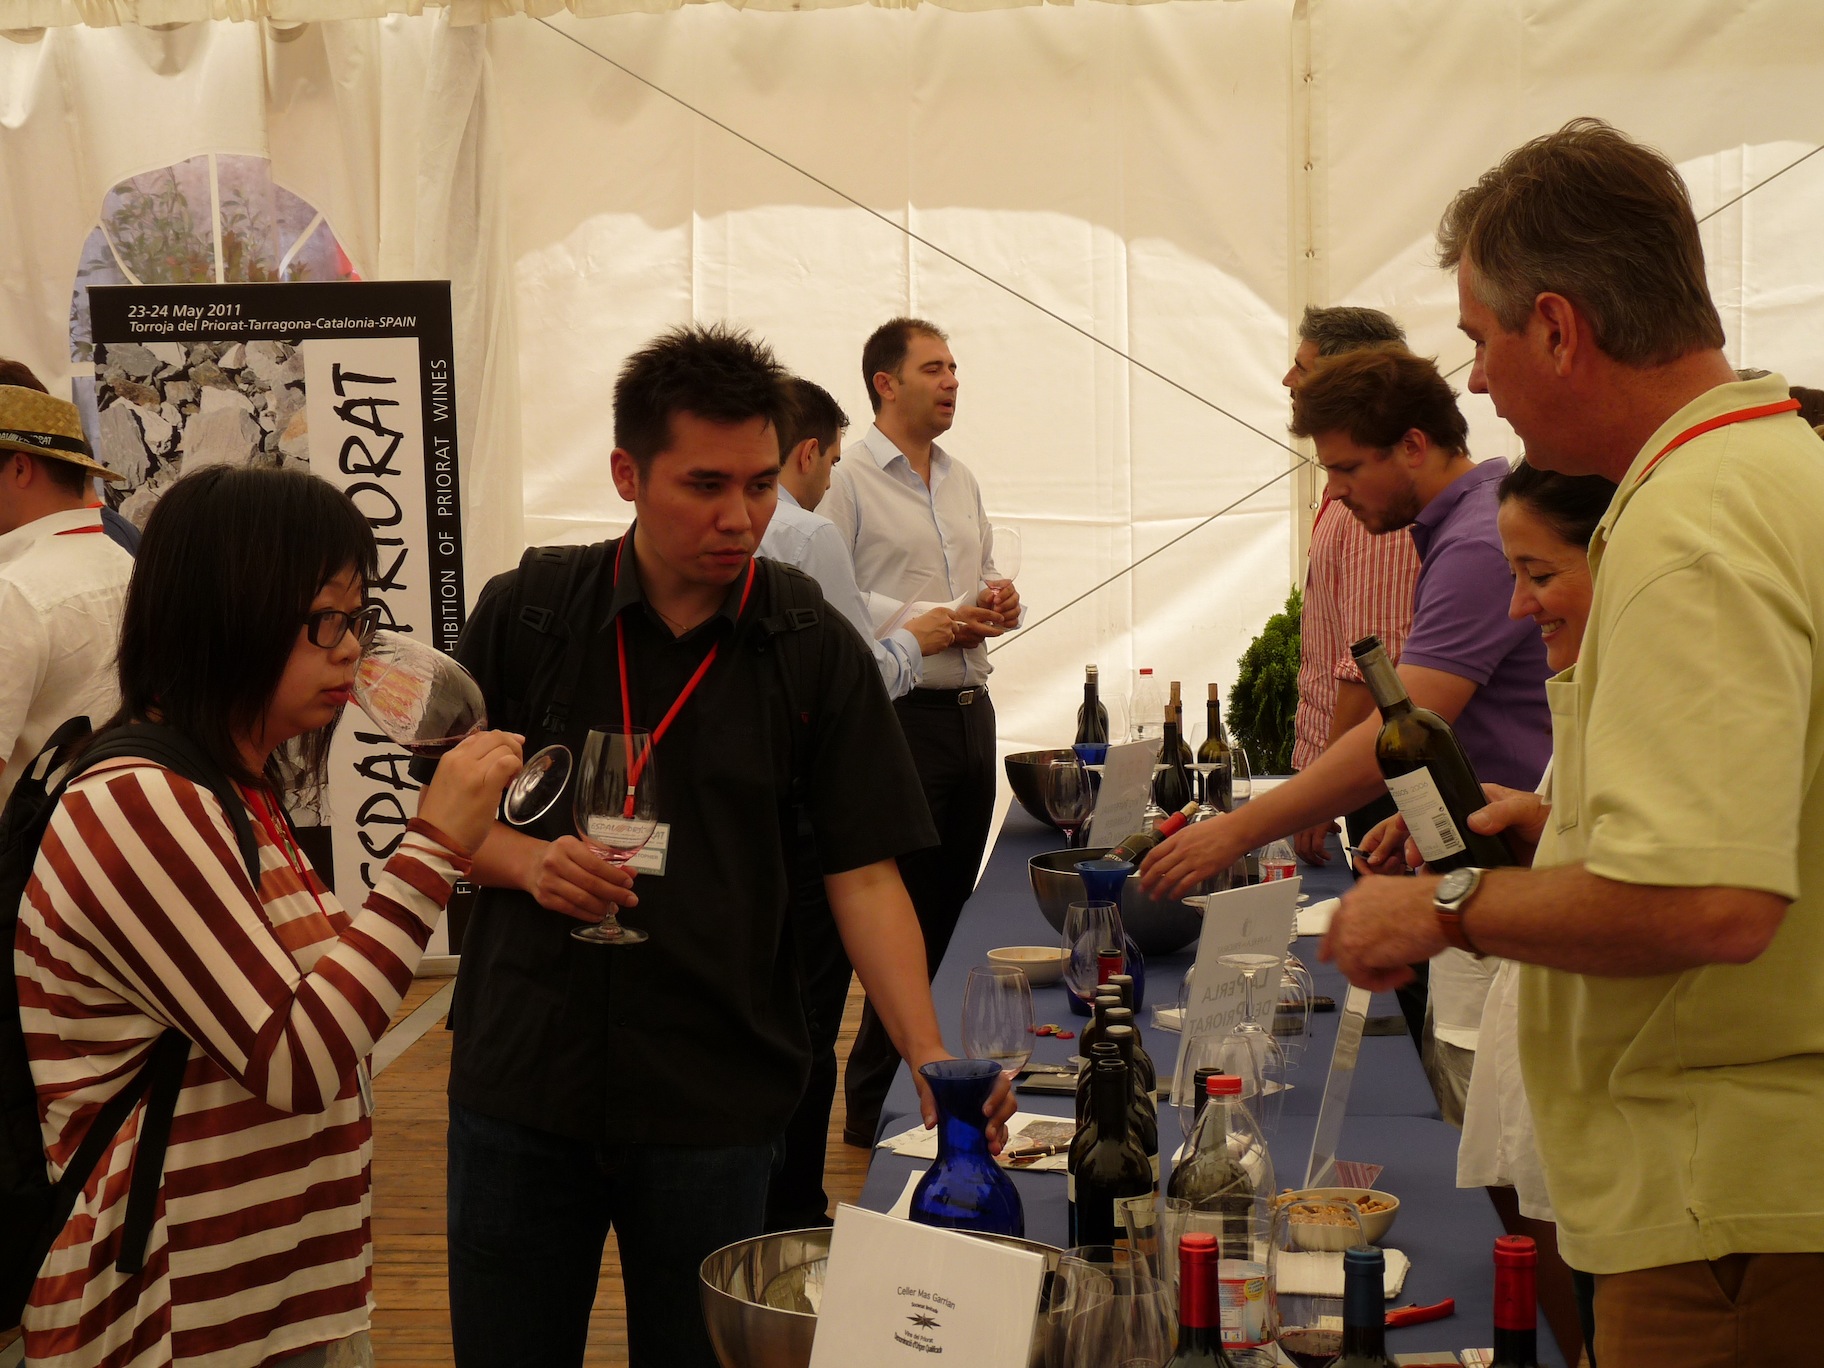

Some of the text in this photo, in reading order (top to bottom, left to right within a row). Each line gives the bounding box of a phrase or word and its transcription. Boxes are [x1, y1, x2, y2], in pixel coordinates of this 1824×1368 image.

[127, 303, 241, 319] 23-24 May 2011
[129, 316, 417, 334] Torroja del Priorat-Tarragona-Catalonia-SPAIN
[431, 359, 459, 652] HIBITION OF PRIORAT WINES
[353, 731, 421, 889] SPAI
[897, 1286, 916, 1296] Celler
[918, 1289, 931, 1300] Mas
